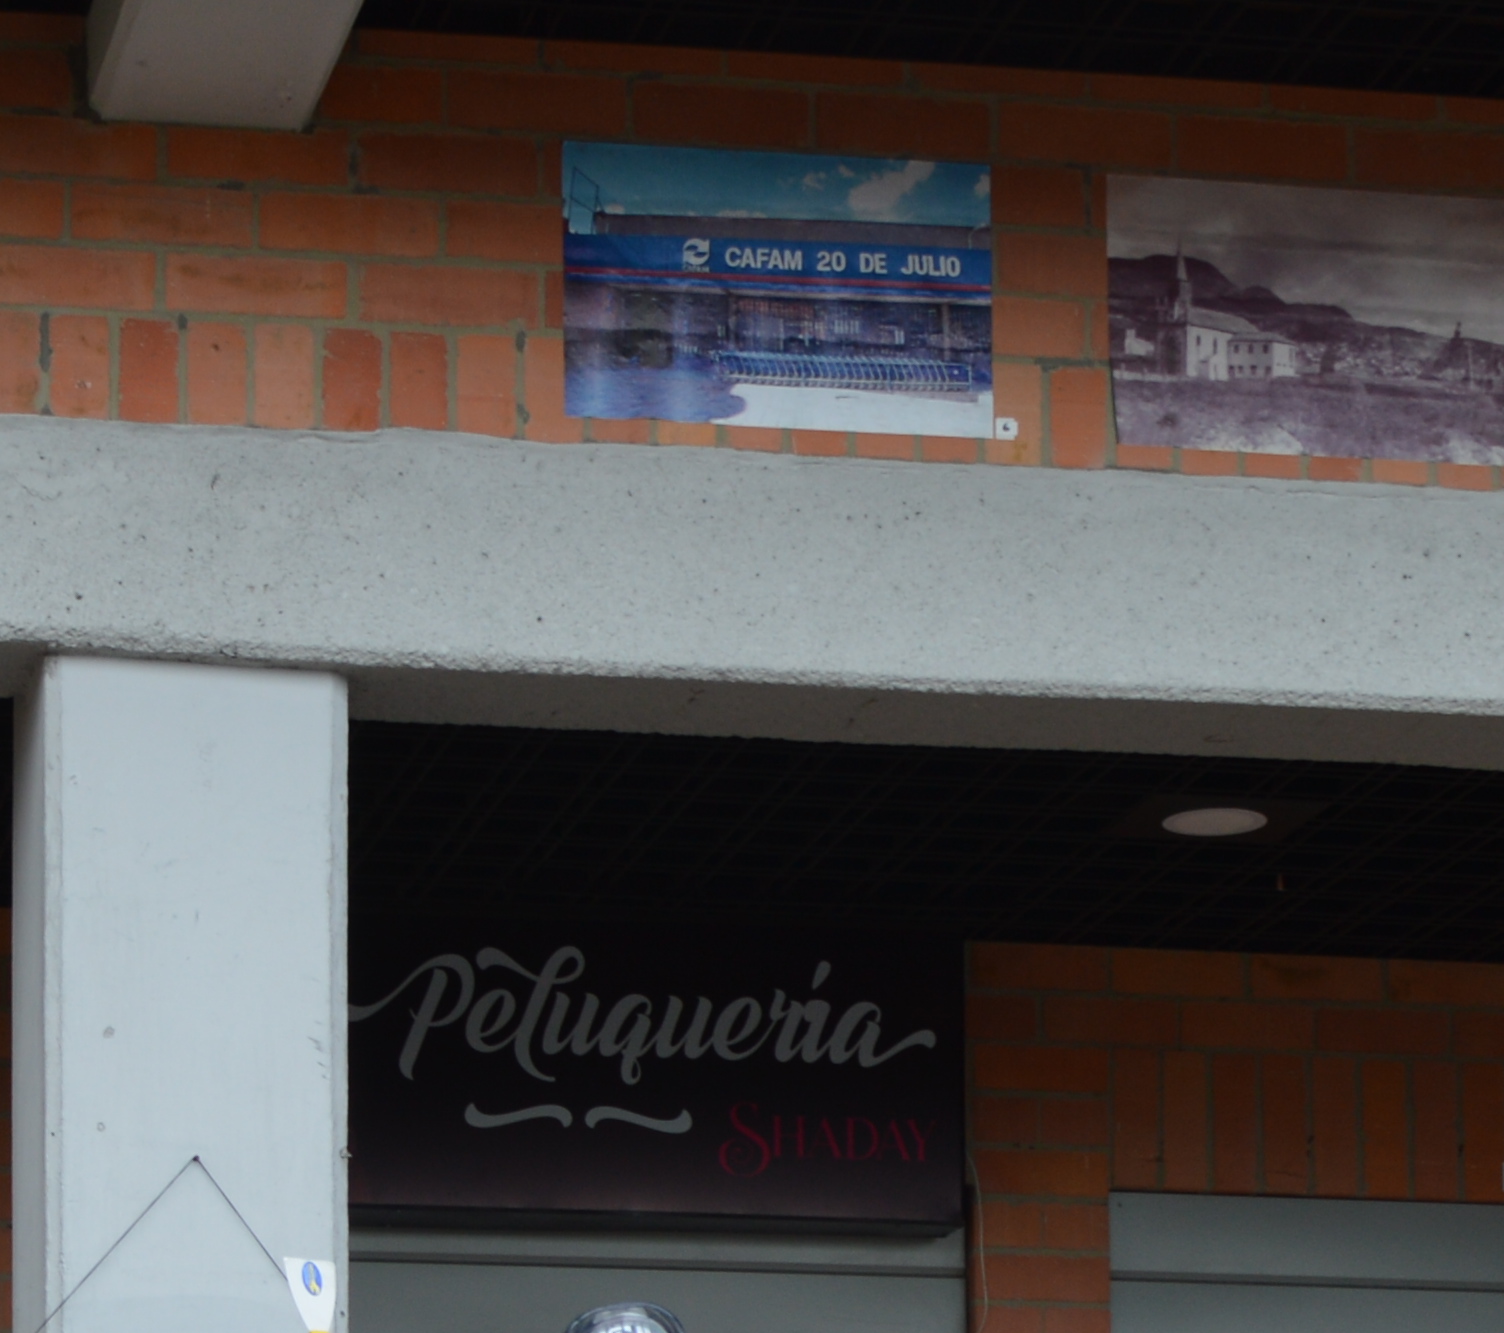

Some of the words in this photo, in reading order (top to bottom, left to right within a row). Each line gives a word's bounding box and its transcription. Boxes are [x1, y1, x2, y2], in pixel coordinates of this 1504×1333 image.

[725, 247, 803, 271] CAFAM
[816, 252, 847, 272] 20
[859, 253, 889, 274] DE
[900, 255, 962, 277] JULIO
[348, 946, 937, 1085] Peluquería
[718, 1101, 939, 1178] SHADAY
